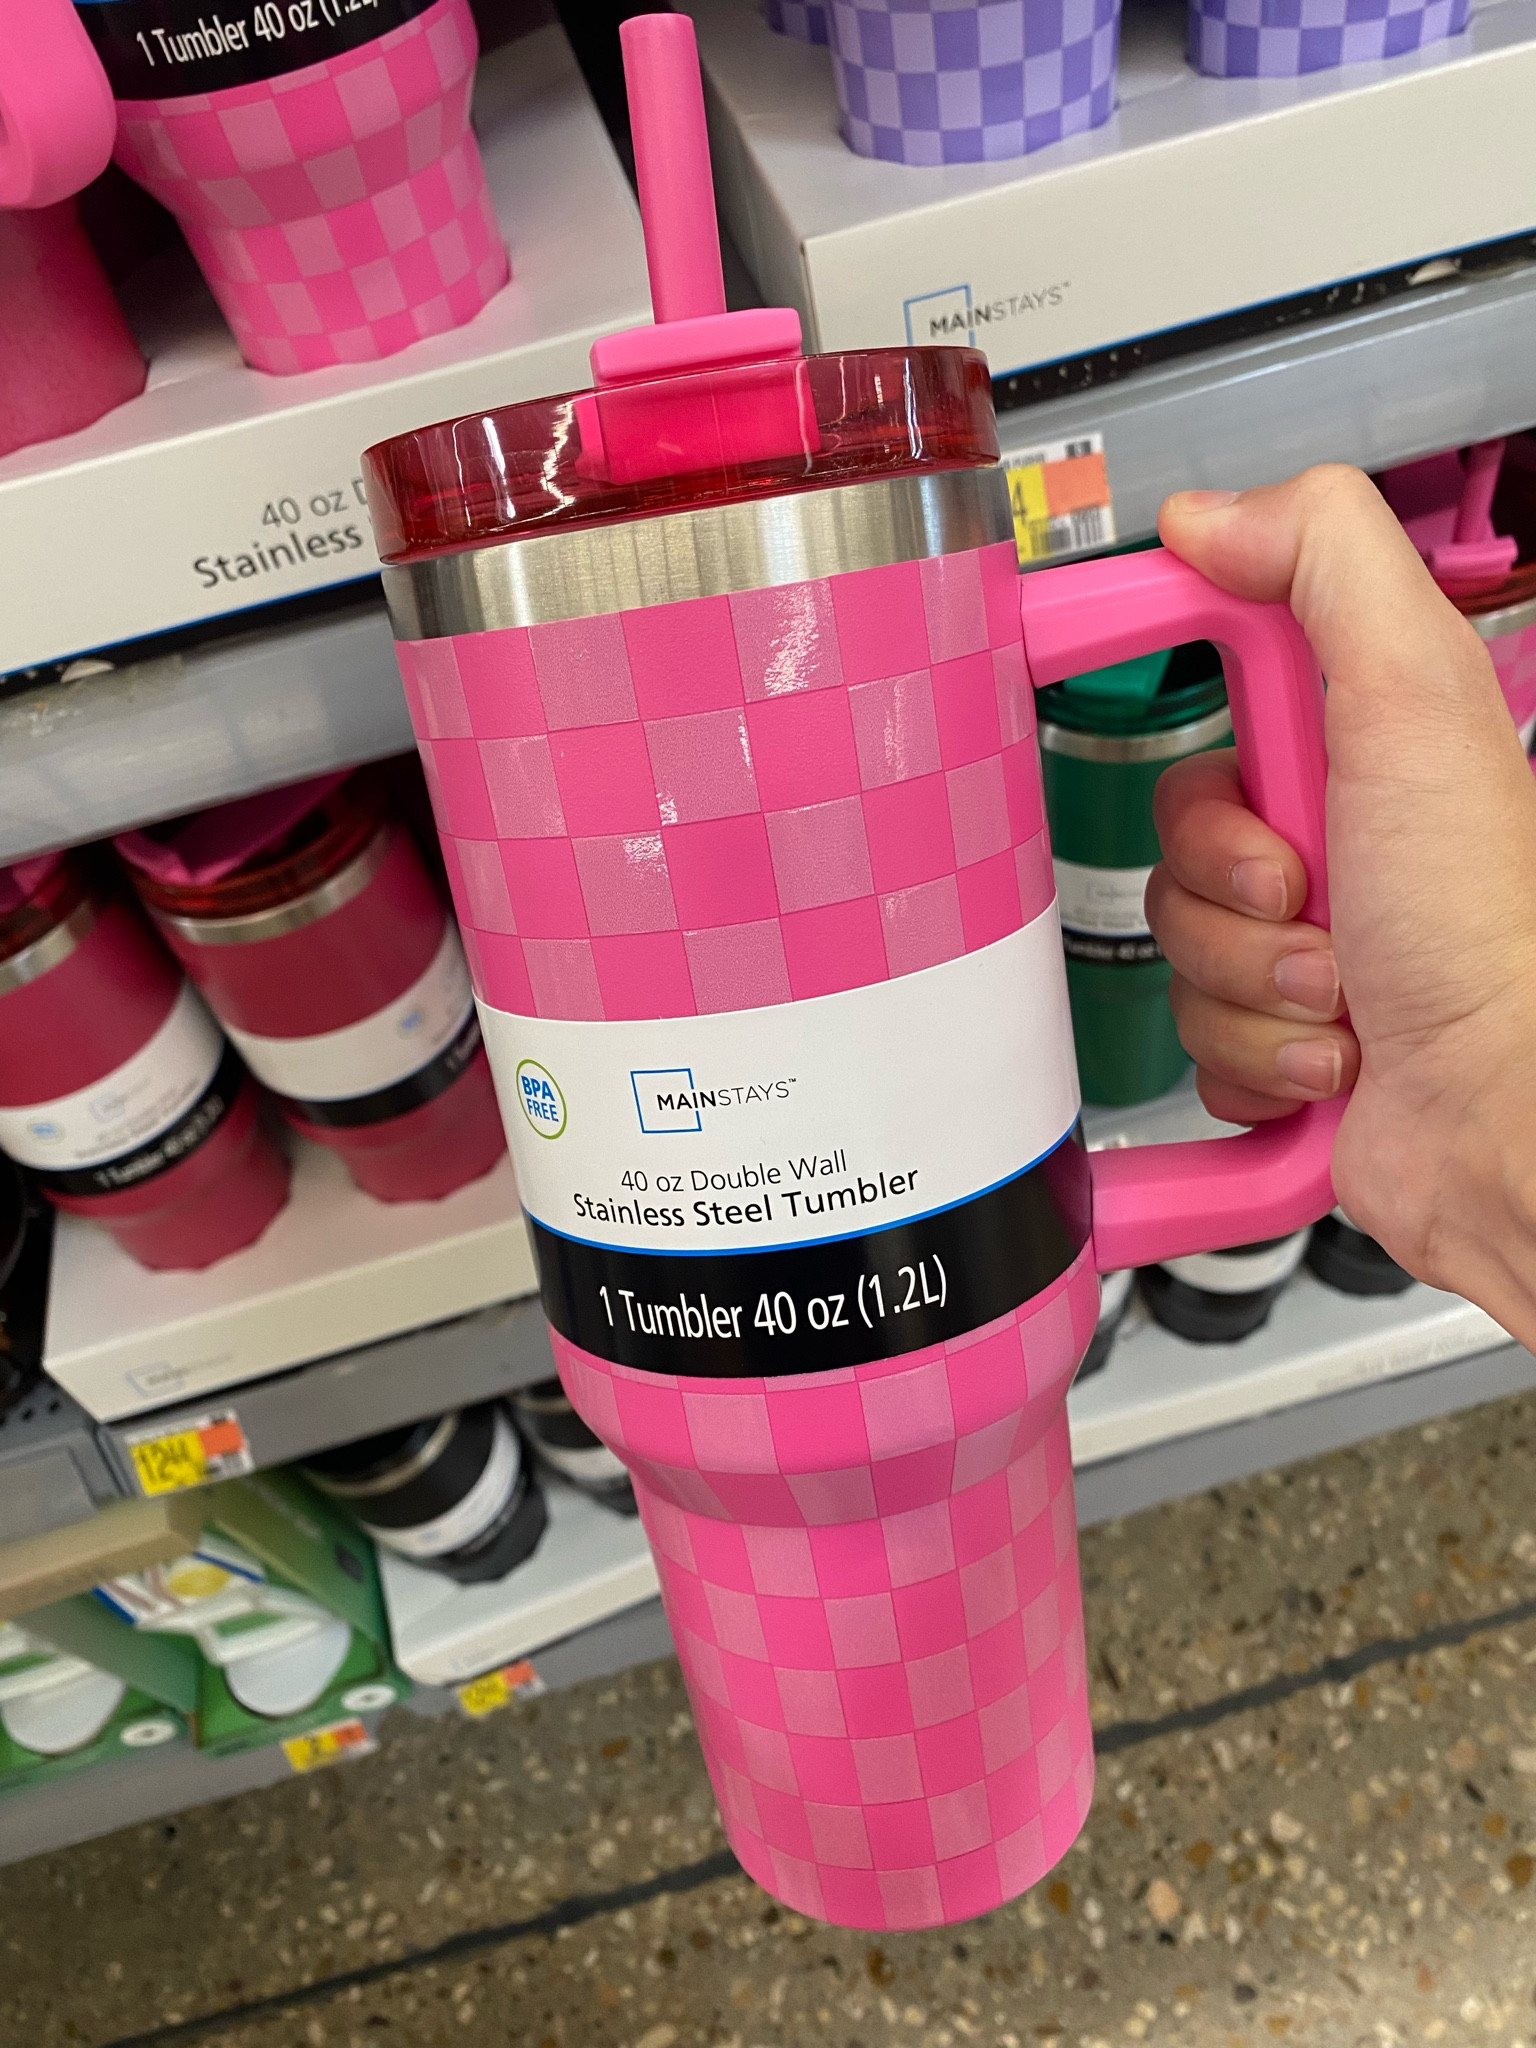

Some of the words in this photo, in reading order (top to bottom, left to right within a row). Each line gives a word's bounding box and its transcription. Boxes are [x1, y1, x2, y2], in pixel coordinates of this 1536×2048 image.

[136, 31, 155, 66] 1
[151, 14, 249, 64] Tumbler
[253, 2, 286, 41] 40
[288, 0, 320, 32] oz
[262, 496, 301, 528] 40
[309, 490, 349, 517] oz
[193, 523, 363, 589] Stainless
[520, 1075, 556, 1102] BPA
[525, 1098, 560, 1123] FREE
[621, 1169, 649, 1192] 40
[656, 1175, 685, 1193] oz
[690, 1163, 782, 1192] Double
[787, 1148, 848, 1181] Wall
[573, 1192, 686, 1227] Stainless
[693, 1193, 774, 1227] Steel
[781, 1168, 920, 1219] Tumbler
[599, 1285, 614, 1327] 1
[618, 1288, 743, 1339] Tumbler
[753, 1290, 797, 1337] 40
[807, 1293, 850, 1331] oz
[857, 1253, 947, 1329] (1.2L)
